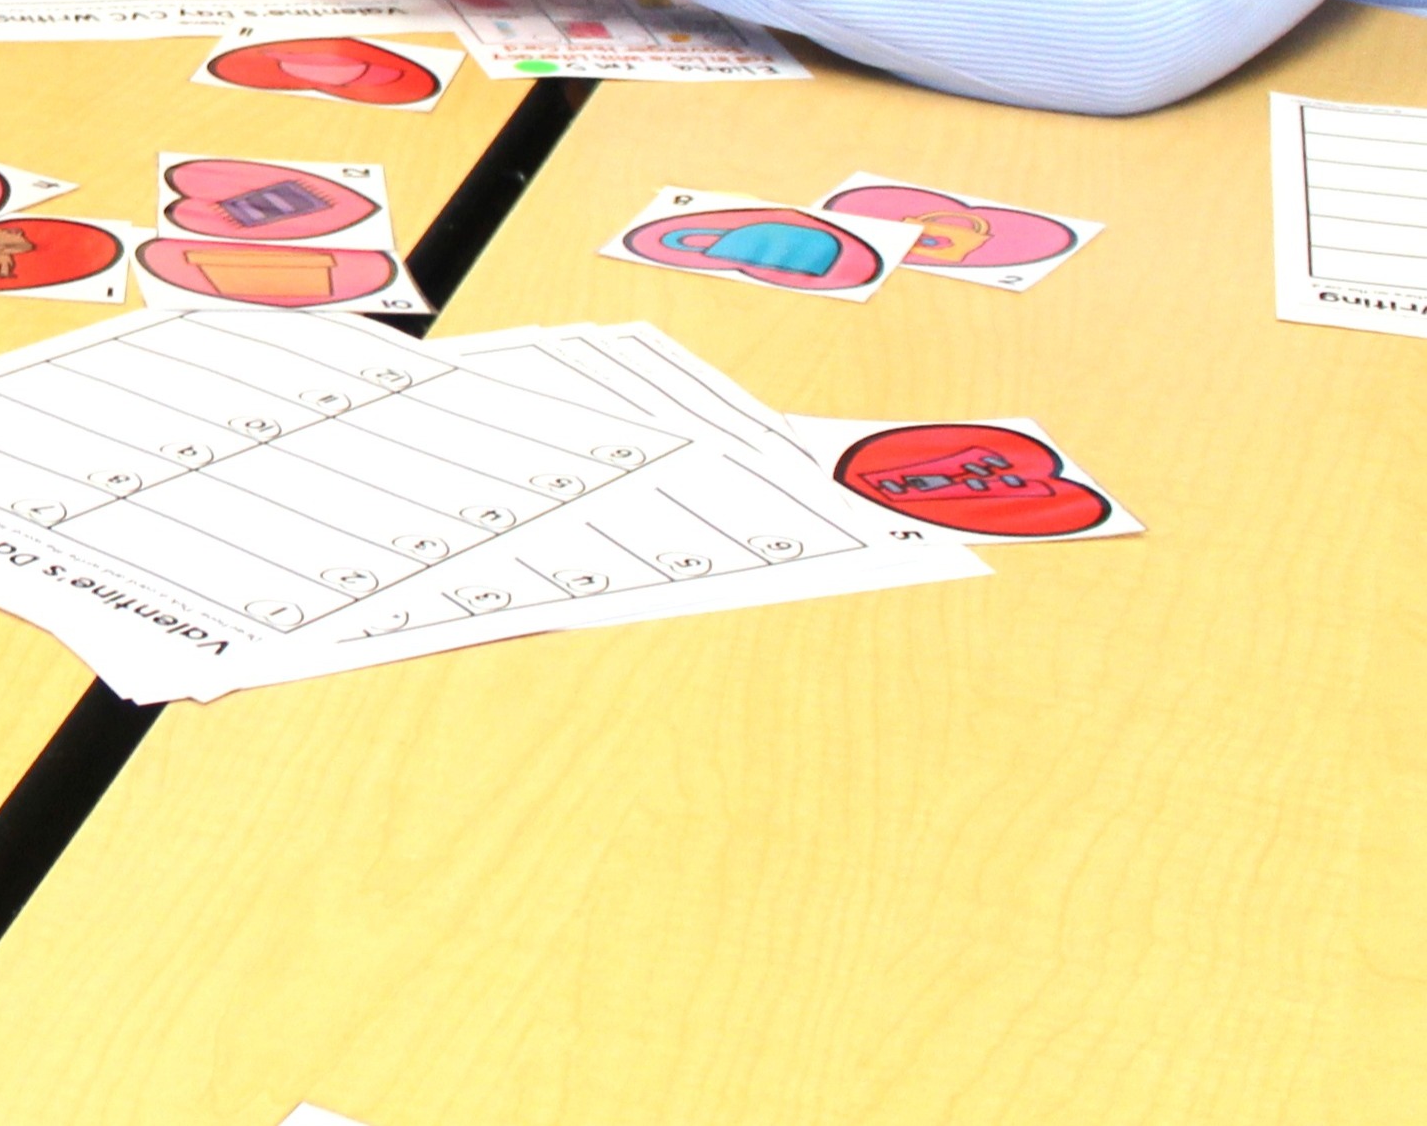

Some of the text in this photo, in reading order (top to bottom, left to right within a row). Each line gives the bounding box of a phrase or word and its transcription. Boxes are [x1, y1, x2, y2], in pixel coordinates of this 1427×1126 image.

[109, 10, 168, 21] CVC
[342, 167, 371, 178] 12
[381, 299, 413, 310] 10
[1319, 291, 1427, 315] riting
[889, 530, 925, 541] 5
[42, 565, 230, 655] Valentine's
